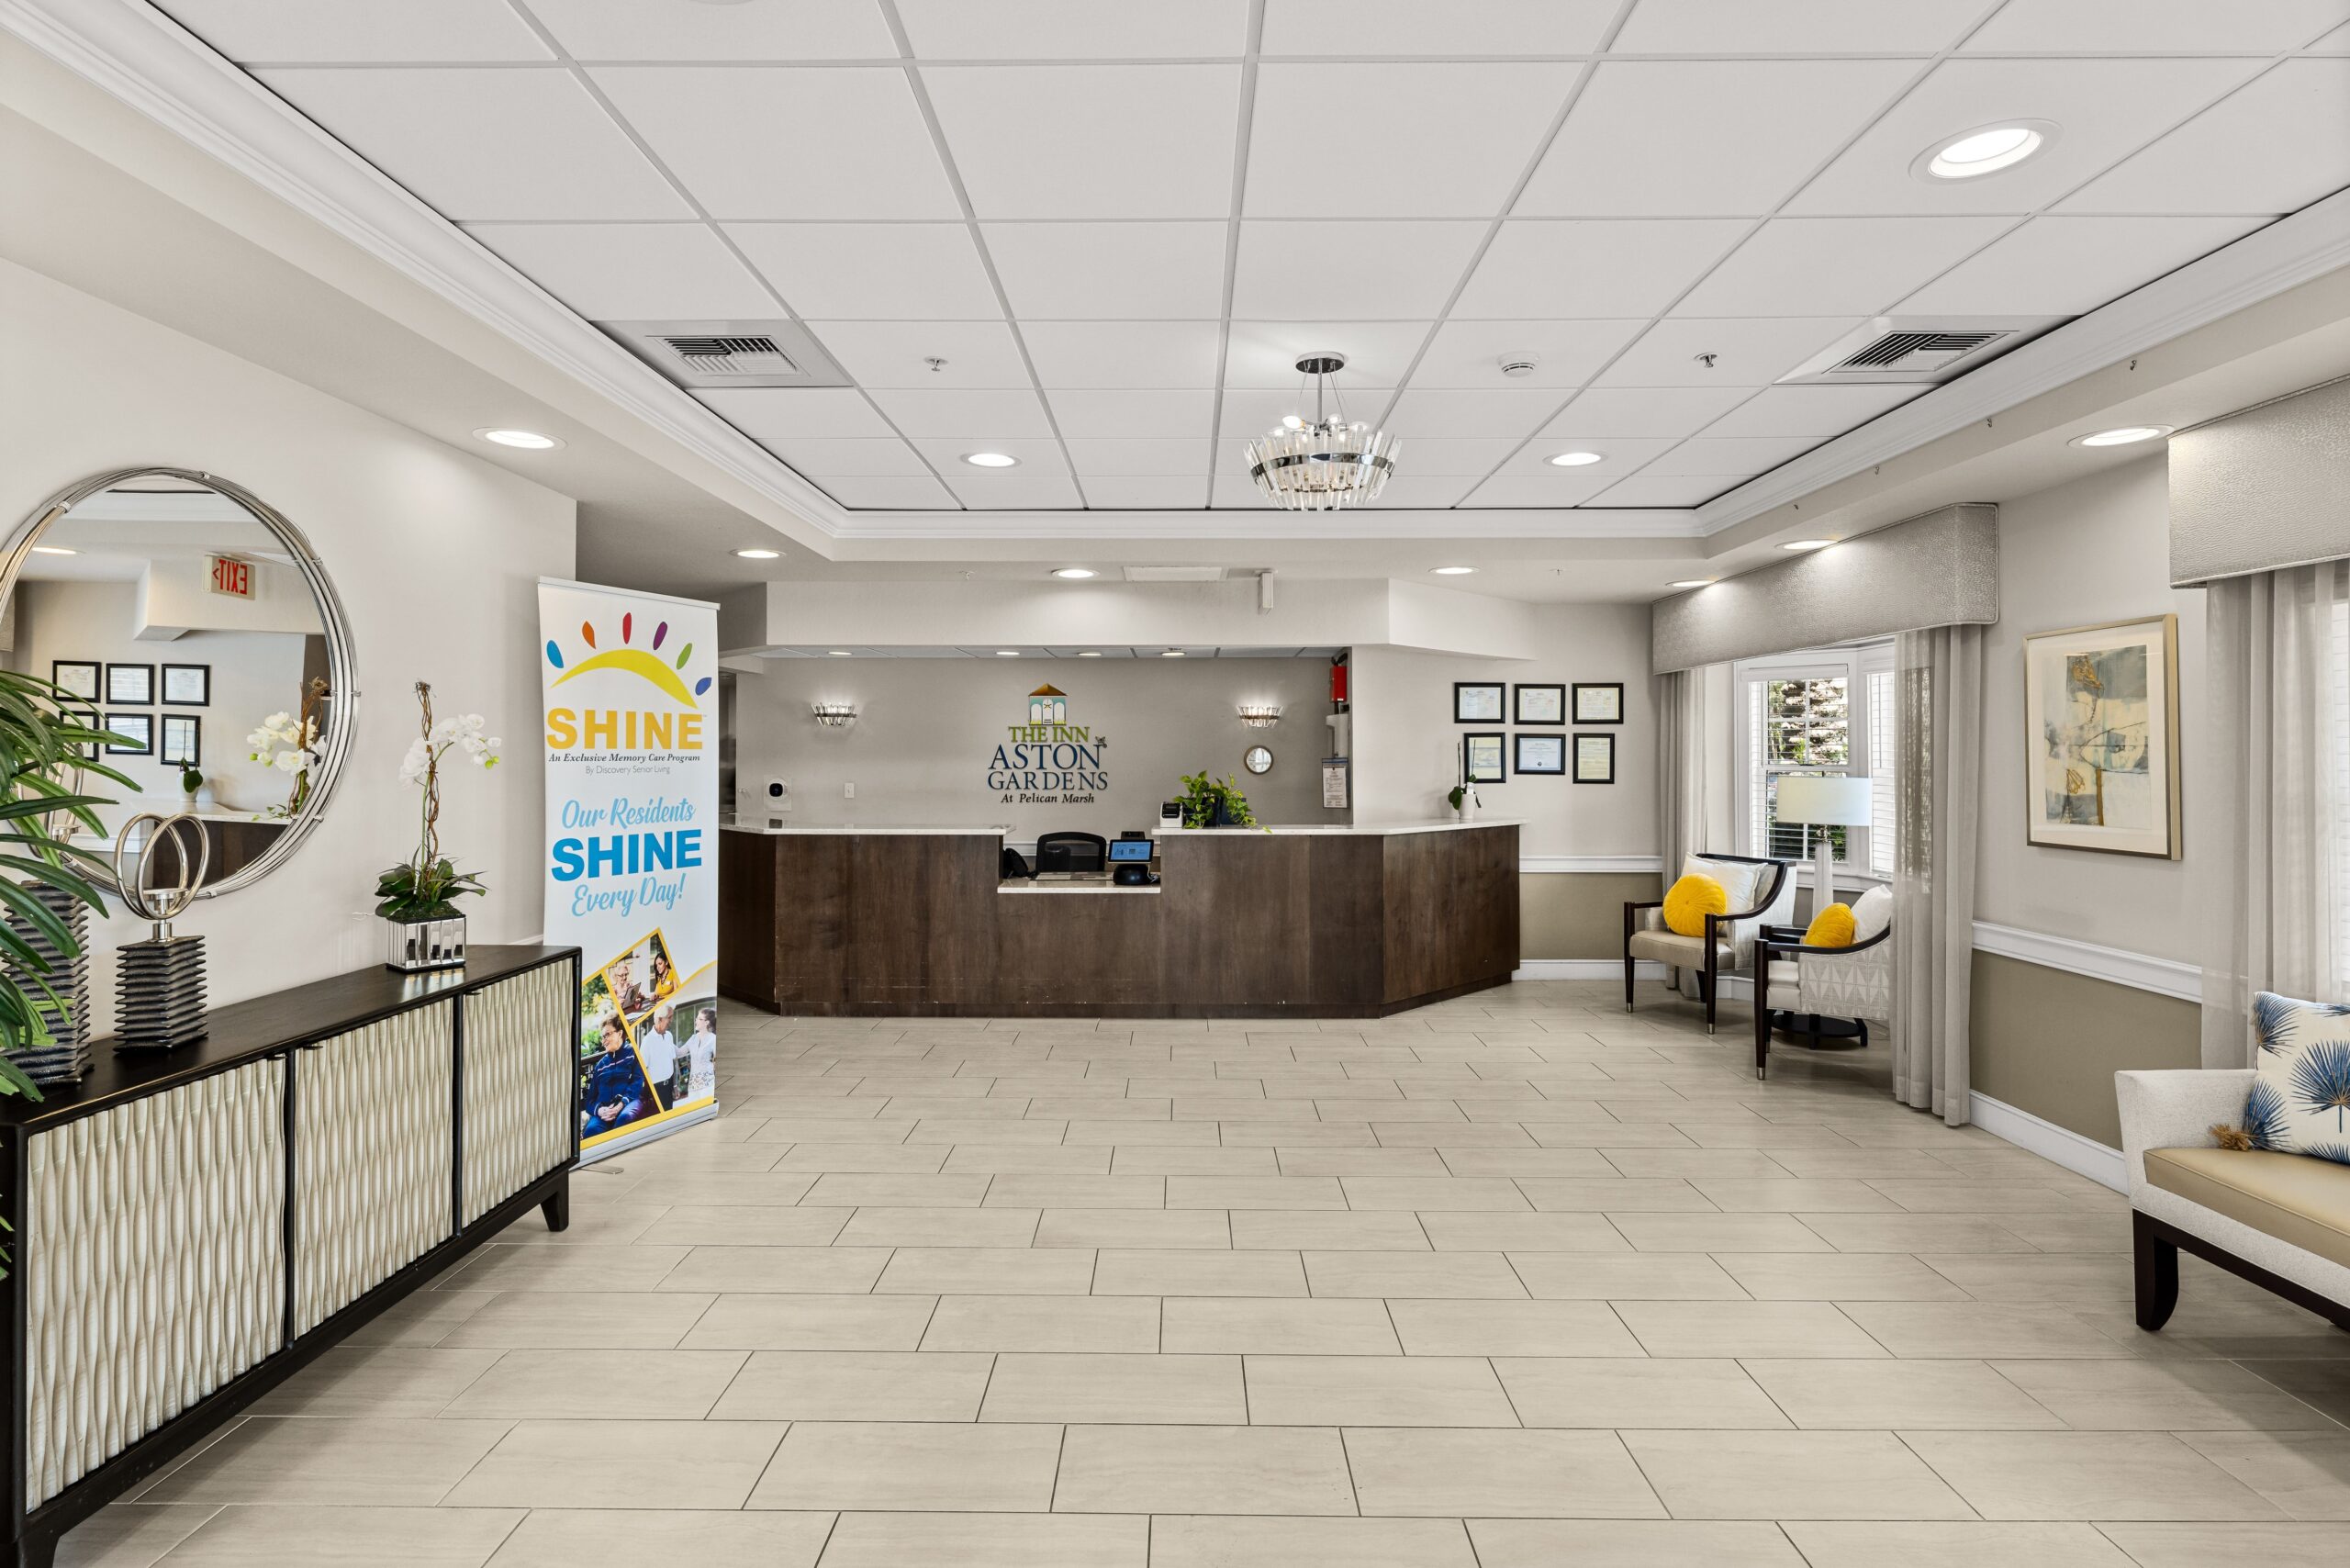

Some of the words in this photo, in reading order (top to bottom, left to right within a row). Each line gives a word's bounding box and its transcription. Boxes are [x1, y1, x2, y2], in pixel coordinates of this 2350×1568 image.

[546, 708, 703, 750] SHINE
[1008, 726, 1048, 743] THE
[1052, 726, 1091, 743] INN
[548, 753, 561, 762] An
[563, 753, 607, 762] Exclusive
[609, 753, 646, 765] Memory
[648, 753, 666, 762] Care
[666, 754, 700, 764] Program
[988, 743, 1104, 770] ASTON
[586, 766, 595, 776] By
[596, 766, 632, 776] Discovery
[632, 766, 654, 774] Senior
[654, 765, 671, 775] Living
[987, 771, 1109, 790] GARDENS
[1001, 792, 1013, 803] At
[1019, 792, 1058, 803] Pelican
[1061, 792, 1095, 803] Marsh
[561, 800, 609, 829] Our
[610, 796, 697, 830] Residents
[551, 829, 702, 882] SHINE
[571, 884, 637, 917] Every
[639, 872, 687, 911] Day!
